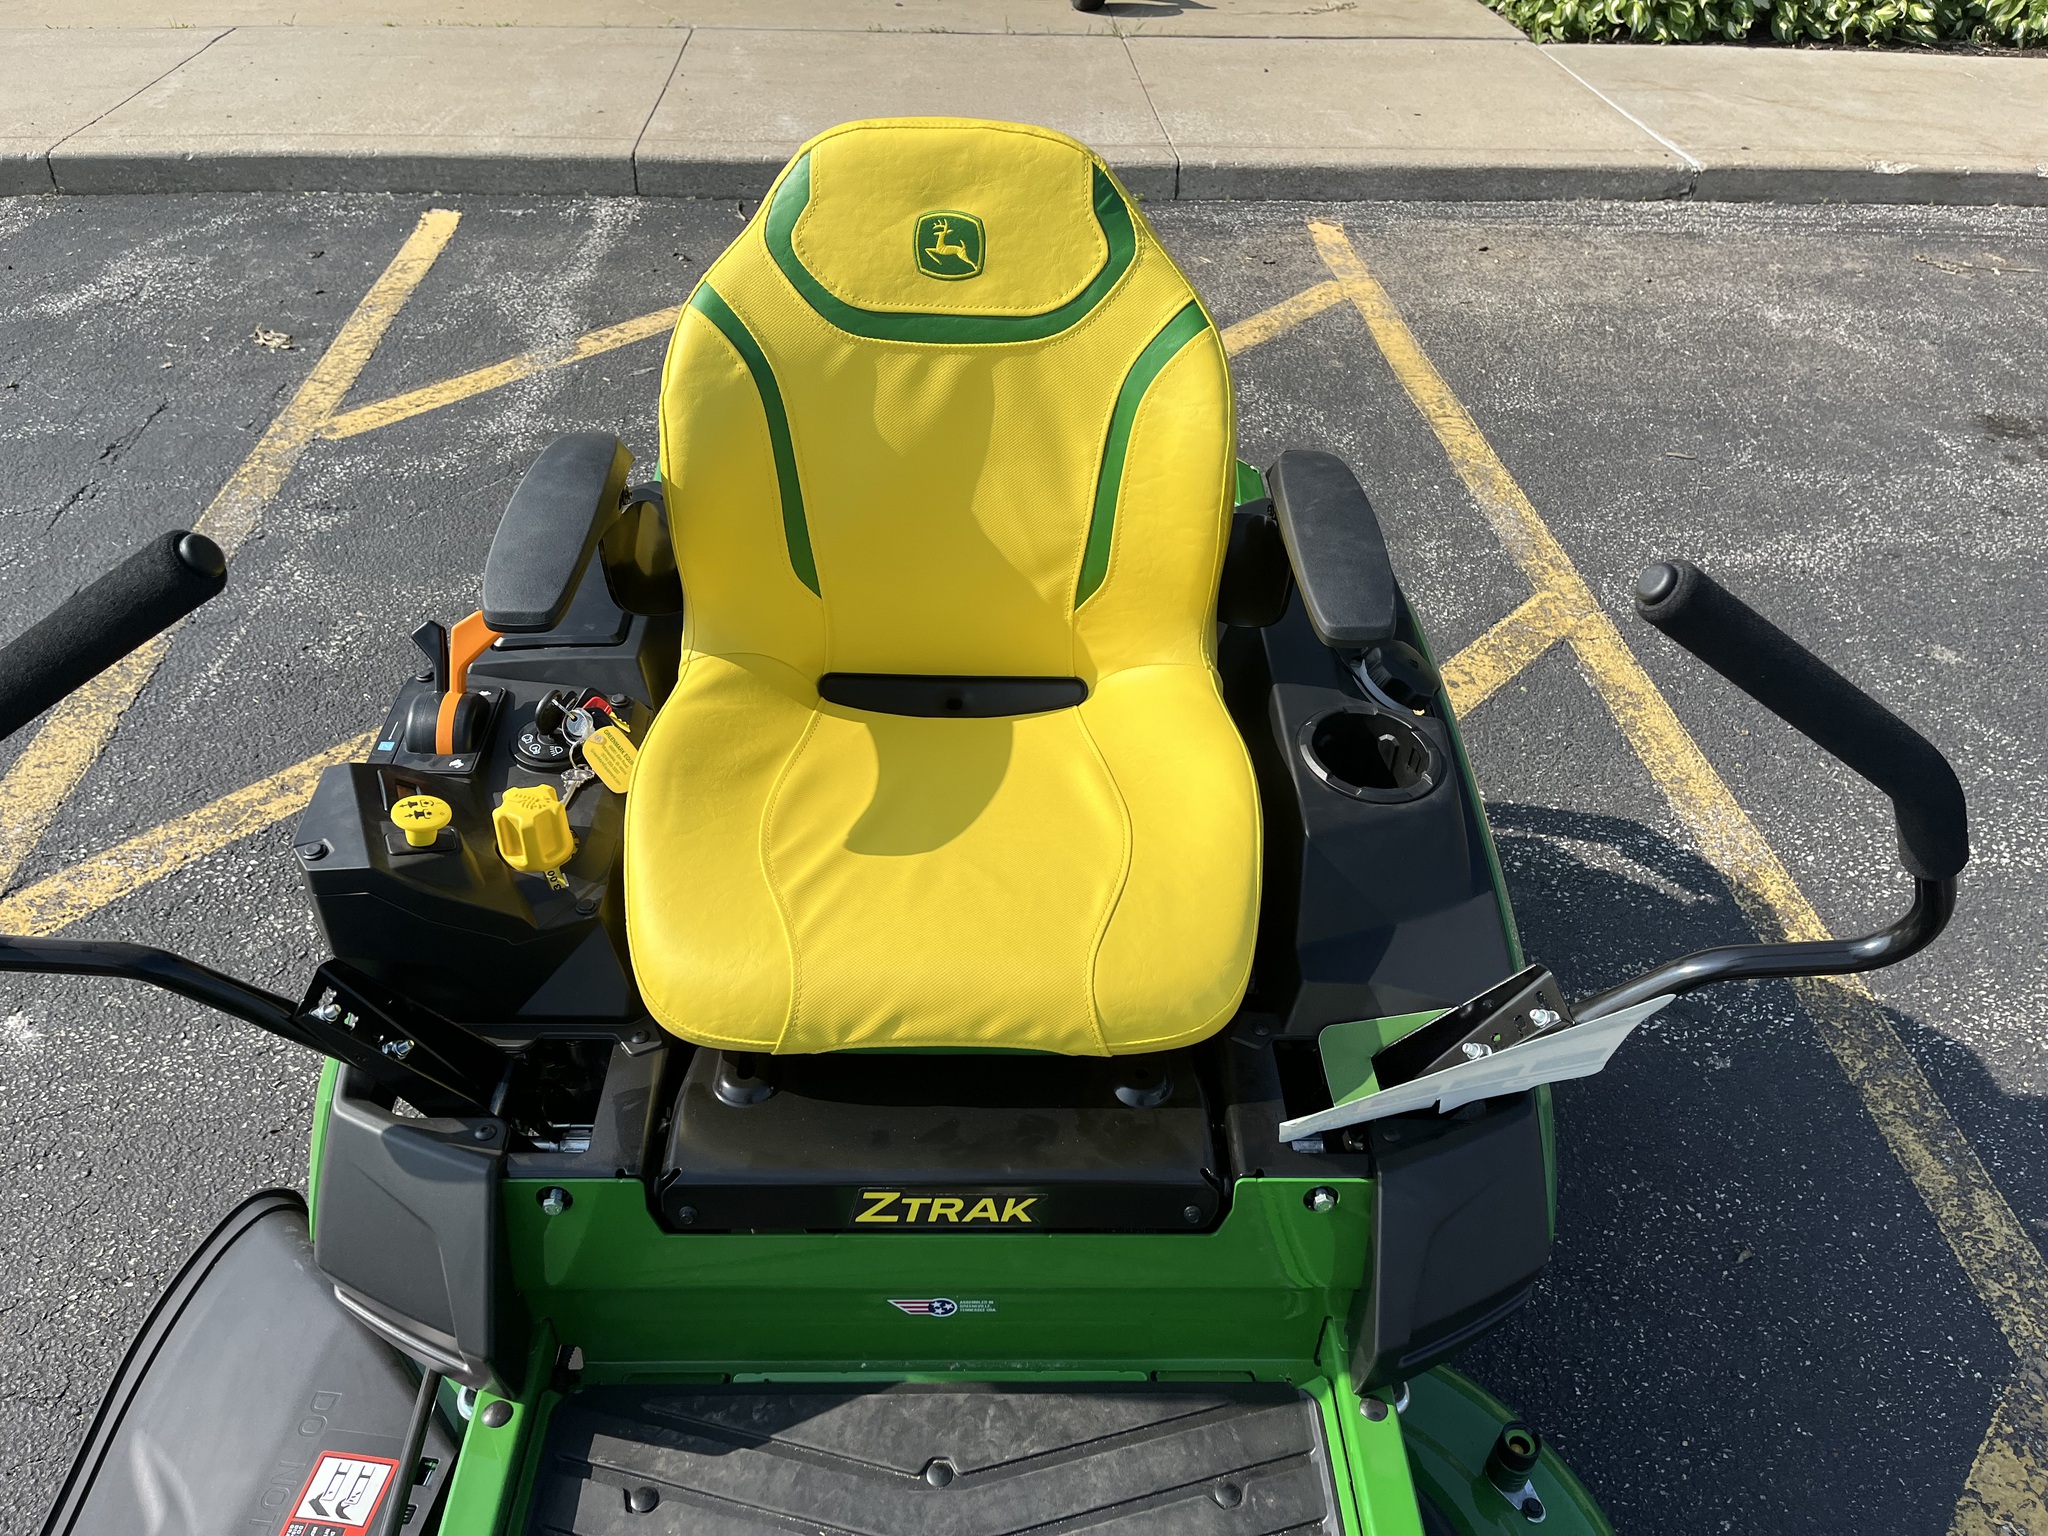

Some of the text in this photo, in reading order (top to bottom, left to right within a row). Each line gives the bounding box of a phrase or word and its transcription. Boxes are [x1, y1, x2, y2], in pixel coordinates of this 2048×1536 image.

[604, 729, 625, 755] GREENMARK
[854, 1191, 1038, 1223] ZTRAK
[248, 1390, 342, 1536] DO NOT
